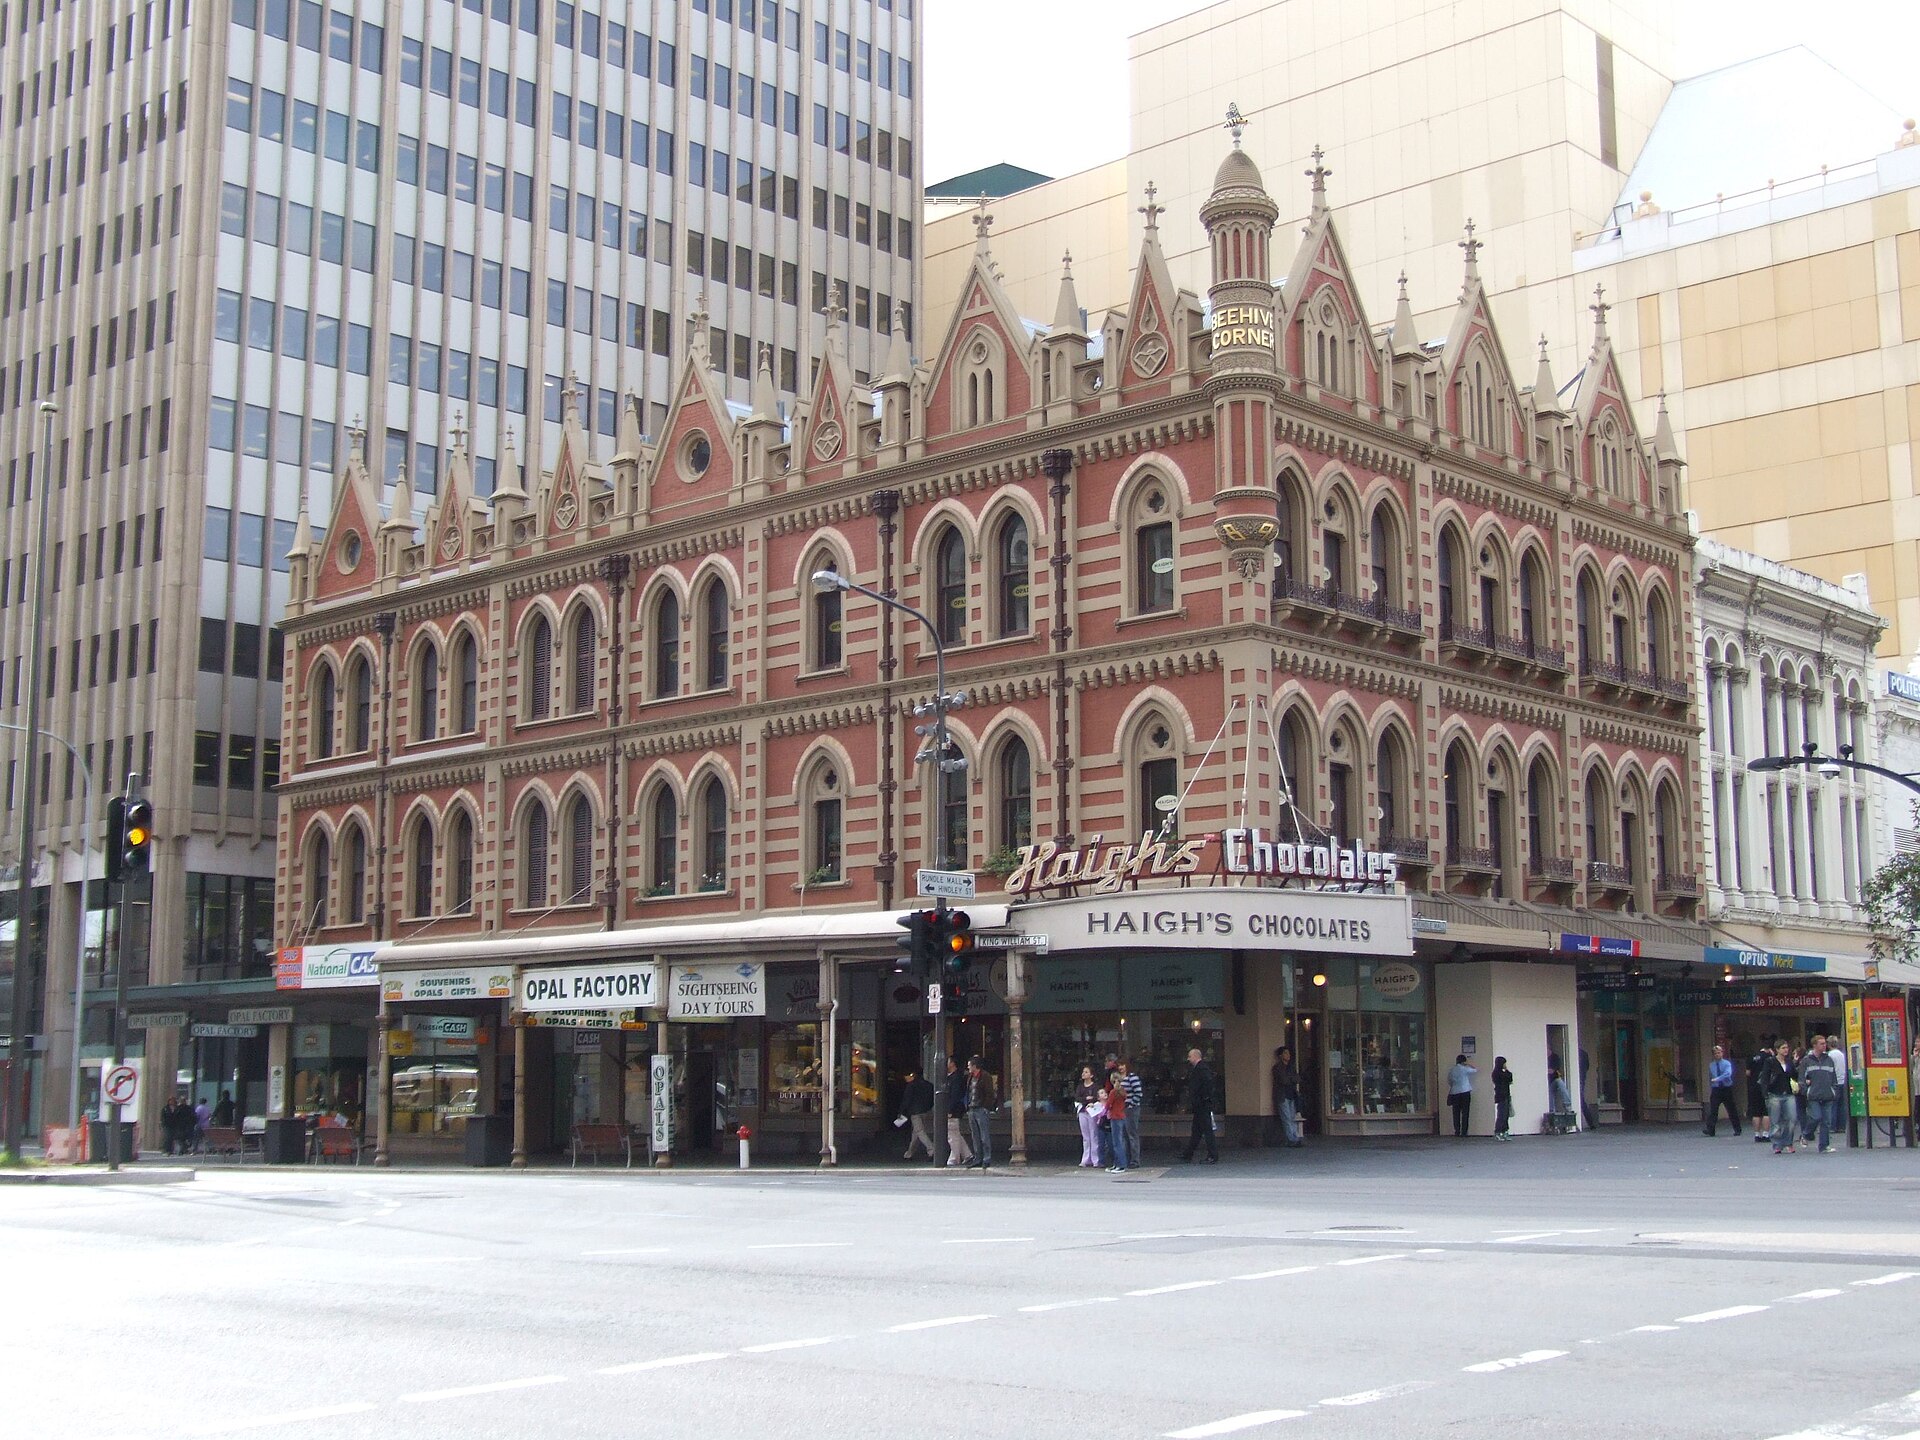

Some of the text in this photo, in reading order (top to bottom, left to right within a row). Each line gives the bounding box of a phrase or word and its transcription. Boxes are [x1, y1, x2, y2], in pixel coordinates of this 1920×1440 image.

[1211, 307, 1274, 331] BEEHIVE
[1212, 328, 1275, 350] CORNER
[1004, 828, 1397, 894] Haighs Chocolates
[921, 874, 963, 885] RUNDLE MALL
[938, 886, 962, 895] HINDLEY
[1088, 911, 1370, 940] HAIGH'S CHOCOLATES
[982, 937, 998, 946] KING
[1001, 936, 1030, 945] WILLIAM
[1739, 951, 1794, 968] OPTUS World
[307, 955, 378, 976] National CAS
[420, 977, 471, 987] SOUVENIRS
[1151, 978, 1193, 987] HAIGH'S
[1375, 974, 1415, 985] HAIGH'S
[1638, 978, 1654, 987] ATM
[527, 973, 651, 1000] OPAL FACTORY
[677, 982, 757, 996] SIGHTSEEING
[1050, 981, 1089, 991] HAIGH'S
[414, 987, 477, 997] OPALS GIFTS
[1679, 991, 1713, 1001] OPTUS
[1768, 995, 1821, 1006] Booksellers
[681, 1001, 754, 1015] DAY TOURS
[150, 1015, 183, 1026] FACTORY
[230, 1009, 290, 1022] OPAL FACTORY
[417, 1023, 467, 1032] Aussie CASH
[545, 1017, 613, 1028] OPALS GIFTS
[193, 1026, 256, 1036] OPAL FACTORY
[577, 1032, 600, 1044] CASH
[653, 1066, 665, 1141] OPALS
